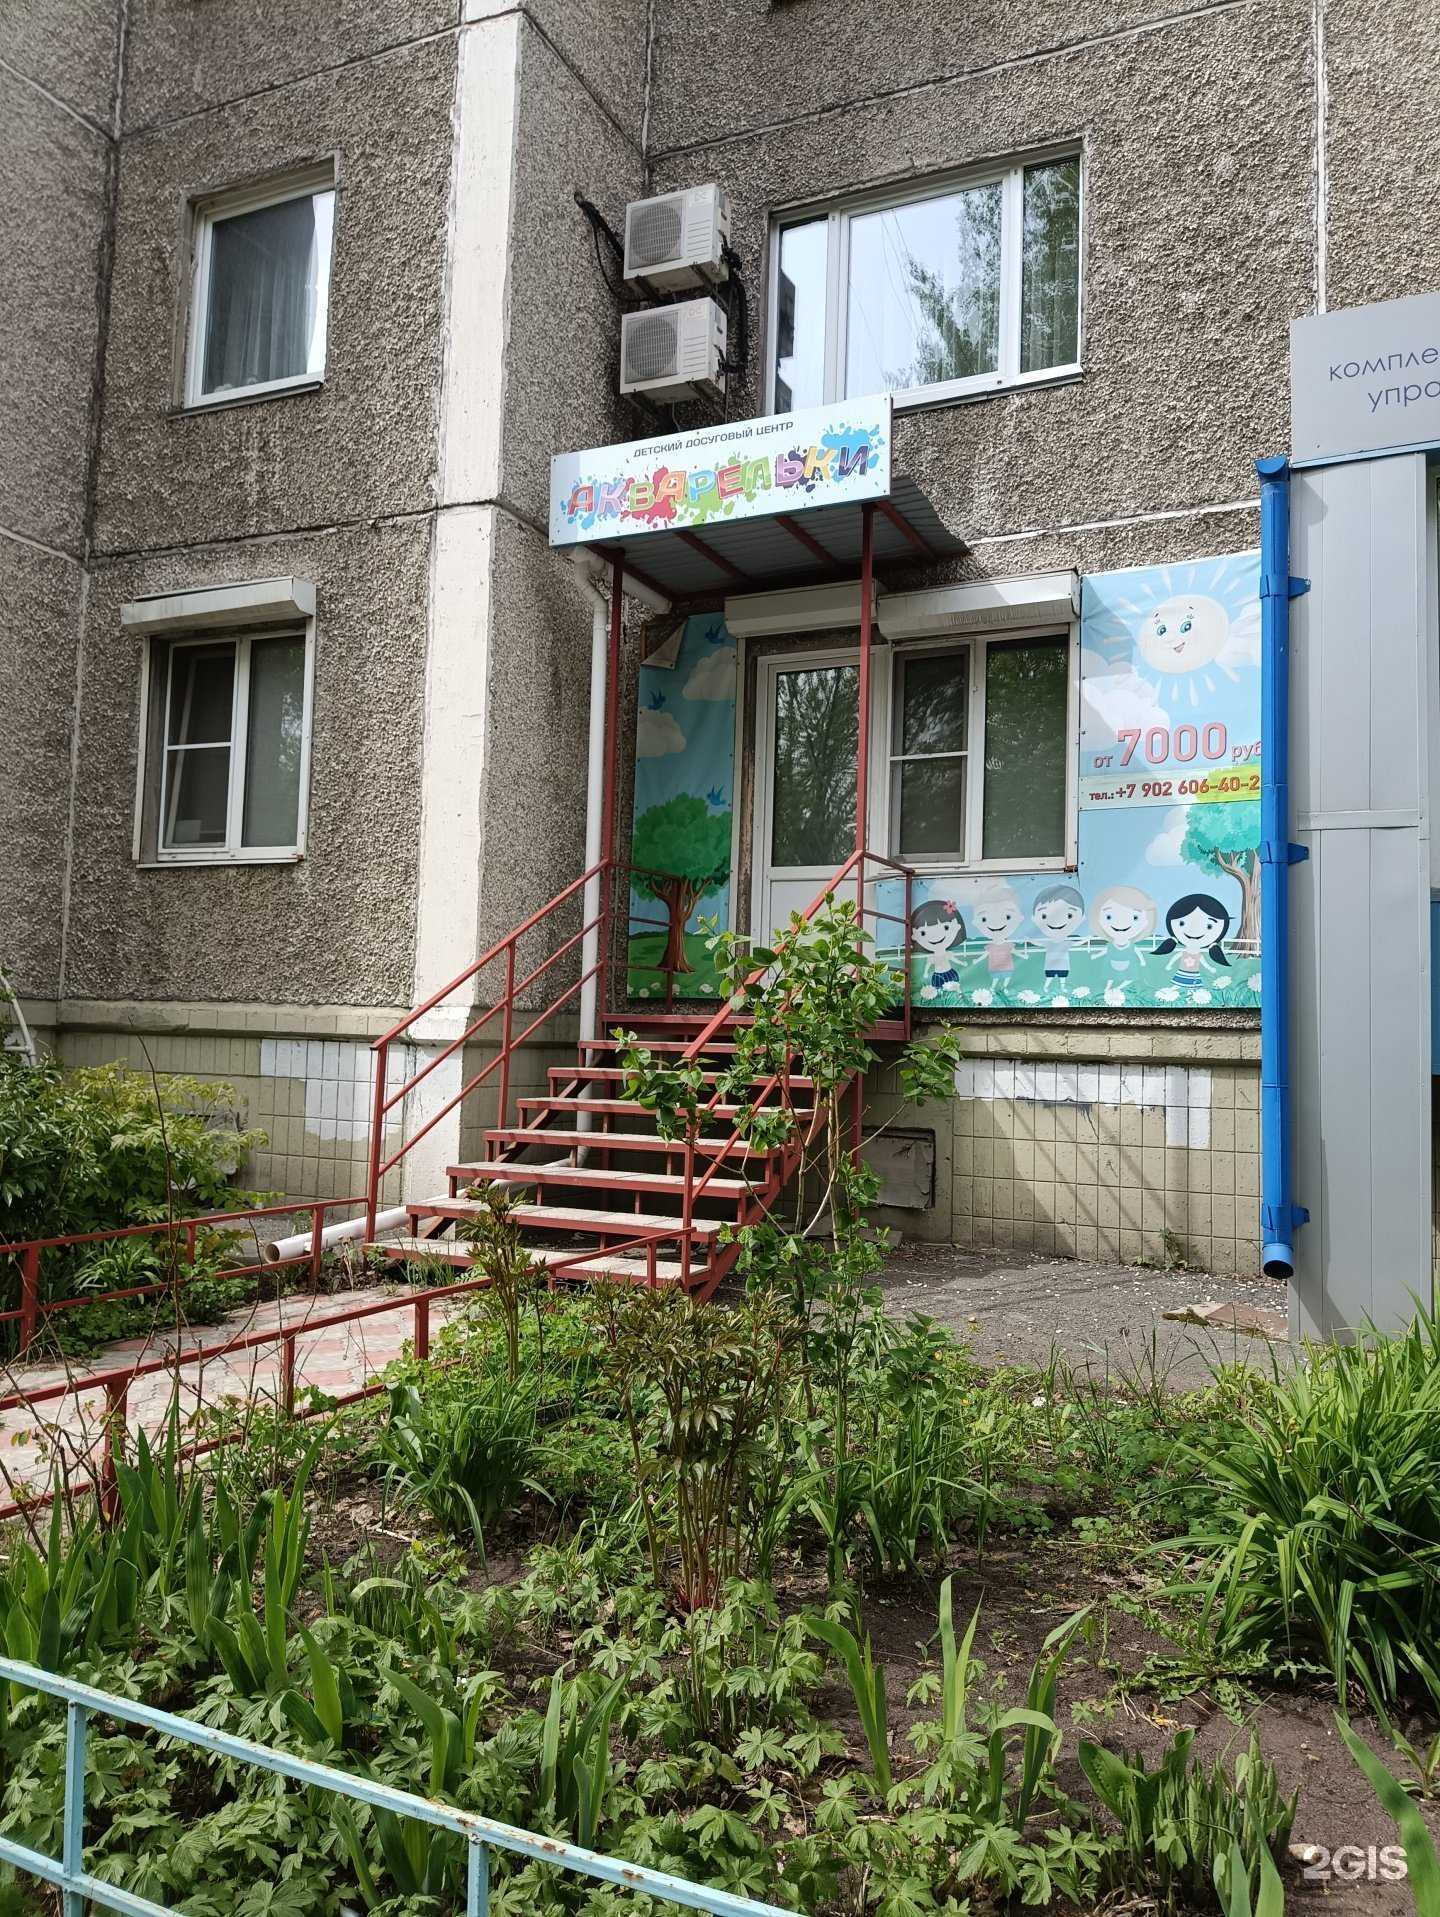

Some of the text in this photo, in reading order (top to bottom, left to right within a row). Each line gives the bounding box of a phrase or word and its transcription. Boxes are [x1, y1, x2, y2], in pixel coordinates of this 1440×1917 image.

[633, 421, 794, 458] ДЕТСКИЙ ДОСУГОВЫЙ ЦЕНТР
[567, 445, 869, 516] АКВАРЕЛЬКИ
[1093, 756, 1114, 768] от
[1117, 722, 1228, 767] 7000
[1141, 781, 1173, 797] 902
[1177, 774, 1261, 796] 606-40-2
